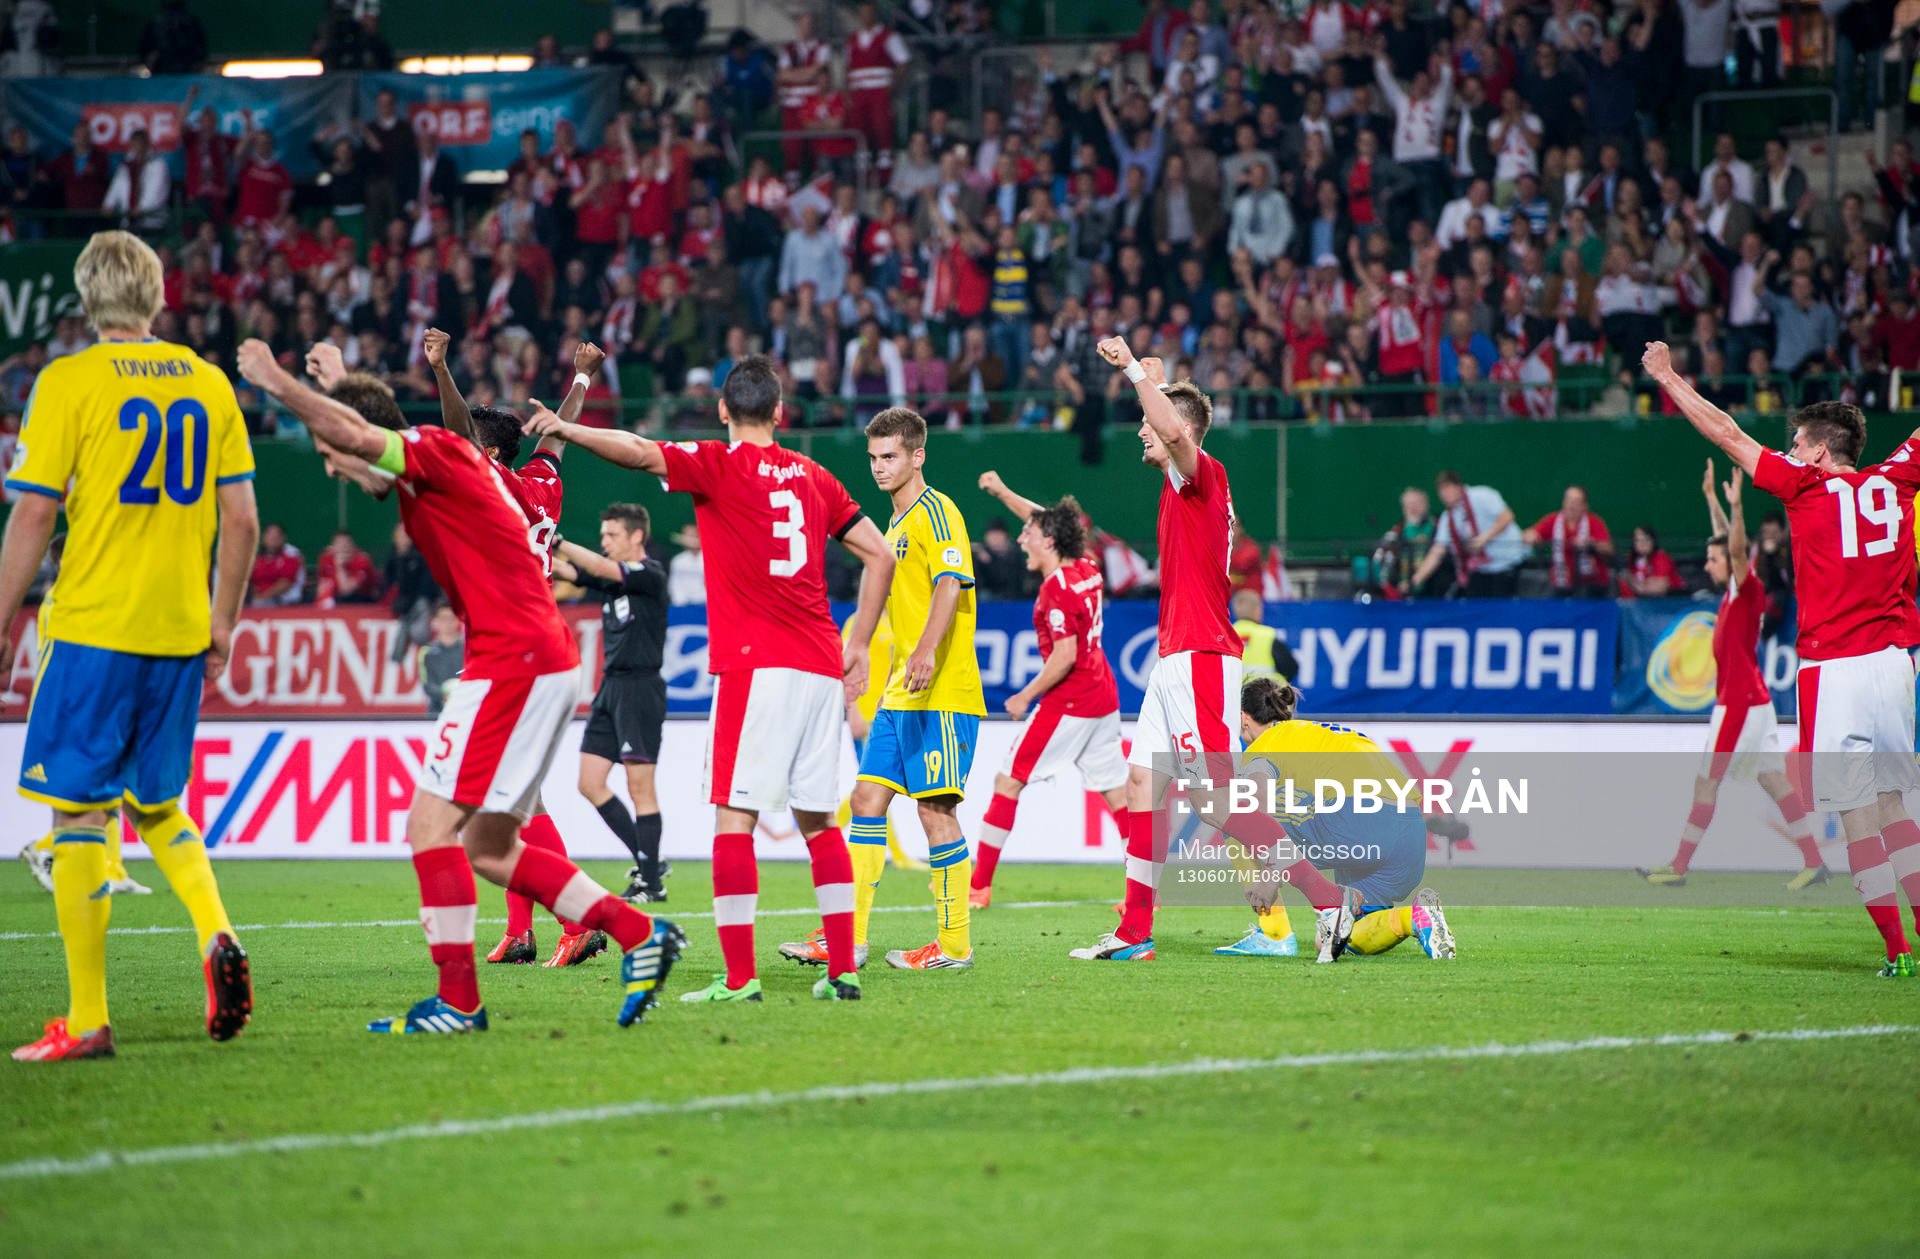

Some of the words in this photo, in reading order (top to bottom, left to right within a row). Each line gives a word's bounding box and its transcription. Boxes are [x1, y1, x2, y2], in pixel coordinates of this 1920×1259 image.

[413, 109, 487, 137] ORF
[112, 359, 192, 377] TOIVONEN
[118, 396, 209, 506] 20
[769, 489, 807, 577] 3
[1825, 475, 1903, 558] 19
[1276, 628, 1598, 690] HYUNDAI
[435, 723, 458, 760] 5
[1172, 731, 1197, 764] 15
[924, 750, 942, 785] 19
